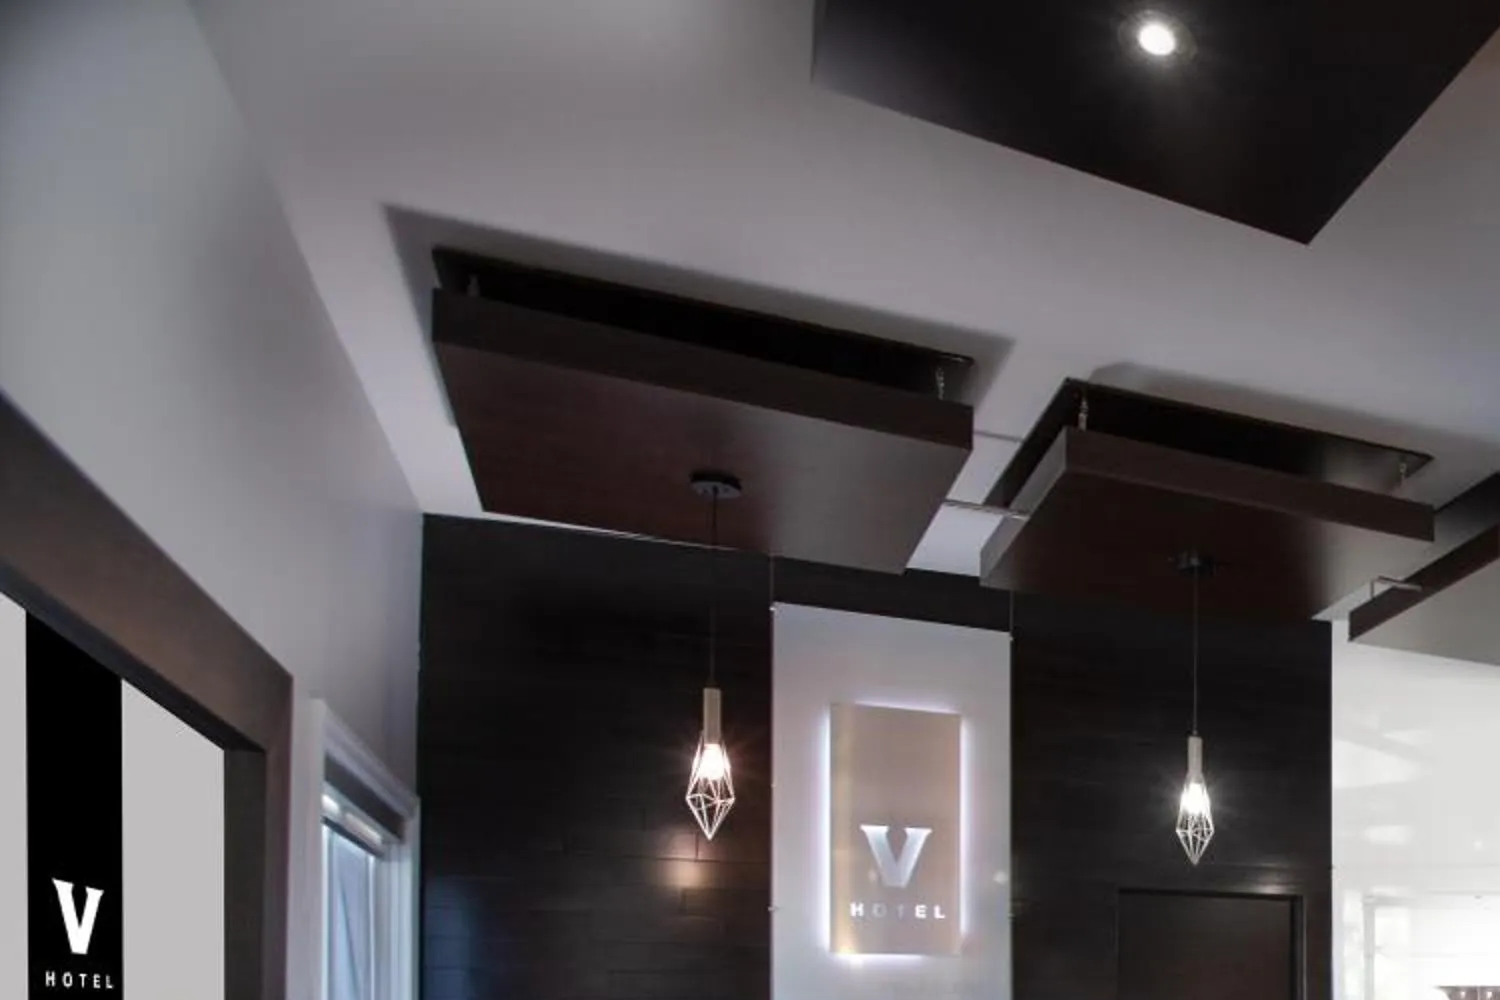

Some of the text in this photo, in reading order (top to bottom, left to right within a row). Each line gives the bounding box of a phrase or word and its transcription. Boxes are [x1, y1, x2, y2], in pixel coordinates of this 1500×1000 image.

[860, 825, 932, 887] V
[52, 877, 104, 955] V
[850, 902, 946, 919] HOTEL
[45, 971, 114, 989] HOTEL
